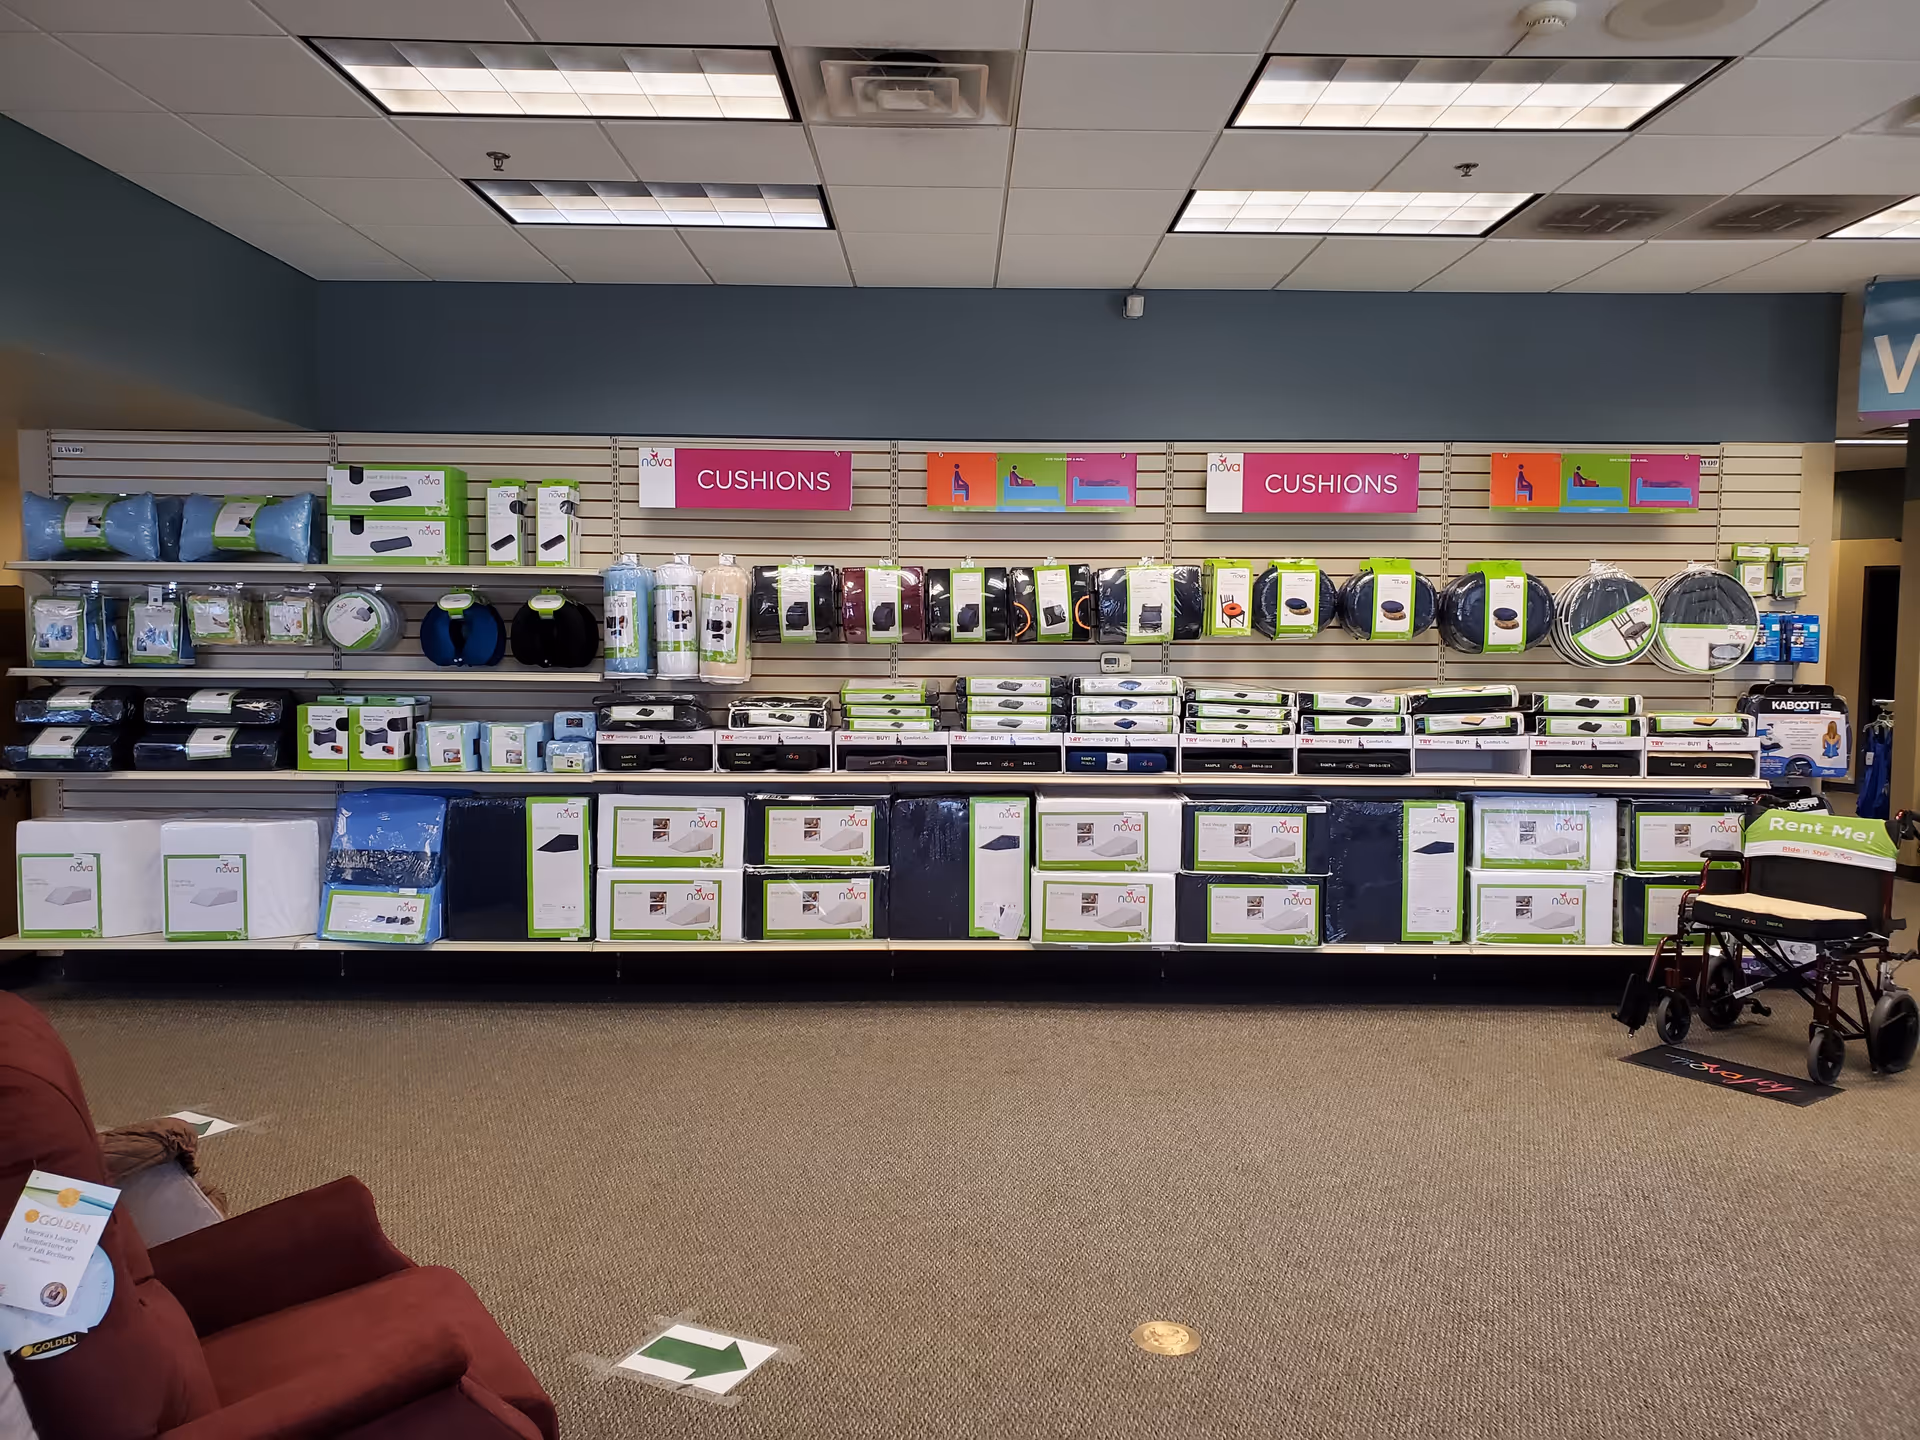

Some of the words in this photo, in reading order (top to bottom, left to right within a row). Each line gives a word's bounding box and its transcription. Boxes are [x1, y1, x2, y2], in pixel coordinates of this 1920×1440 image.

[642, 455, 672, 467] nova
[1210, 461, 1240, 472] nova
[418, 477, 440, 486] nova
[698, 470, 831, 491] CUSHIONS
[1265, 474, 1398, 494] CUSHIONS
[418, 528, 440, 536] nova
[1772, 701, 1820, 710] KABOOTI
[557, 810, 579, 819] nova
[999, 810, 1020, 818] nova
[1433, 814, 1454, 823] nova
[690, 818, 718, 828] nova
[840, 817, 867, 827] nova
[1556, 822, 1583, 831] nova
[1114, 822, 1141, 832] nova
[1272, 824, 1299, 833] nova
[1711, 824, 1737, 833] nova
[1769, 817, 1824, 835] Rent
[1832, 824, 1875, 844] Me!
[1812, 849, 1830, 858] Style
[70, 863, 93, 872] nova
[216, 864, 239, 873] nova
[687, 891, 714, 900] nova
[839, 890, 866, 900] nova
[1118, 894, 1145, 903] nova
[1284, 896, 1312, 905] nova
[1552, 896, 1579, 905] nova
[397, 904, 417, 912] nova
[38, 1214, 91, 1235] GOLDEN
[24, 1228, 53, 1239] America's
[54, 1234, 78, 1245] Largest
[24, 1236, 64, 1250] Manufacturer
[13, 1243, 32, 1252] Power
[34, 1247, 45, 1255] Lift
[46, 1250, 75, 1261] Recliners
[33, 1335, 77, 1353] GOLDEN
